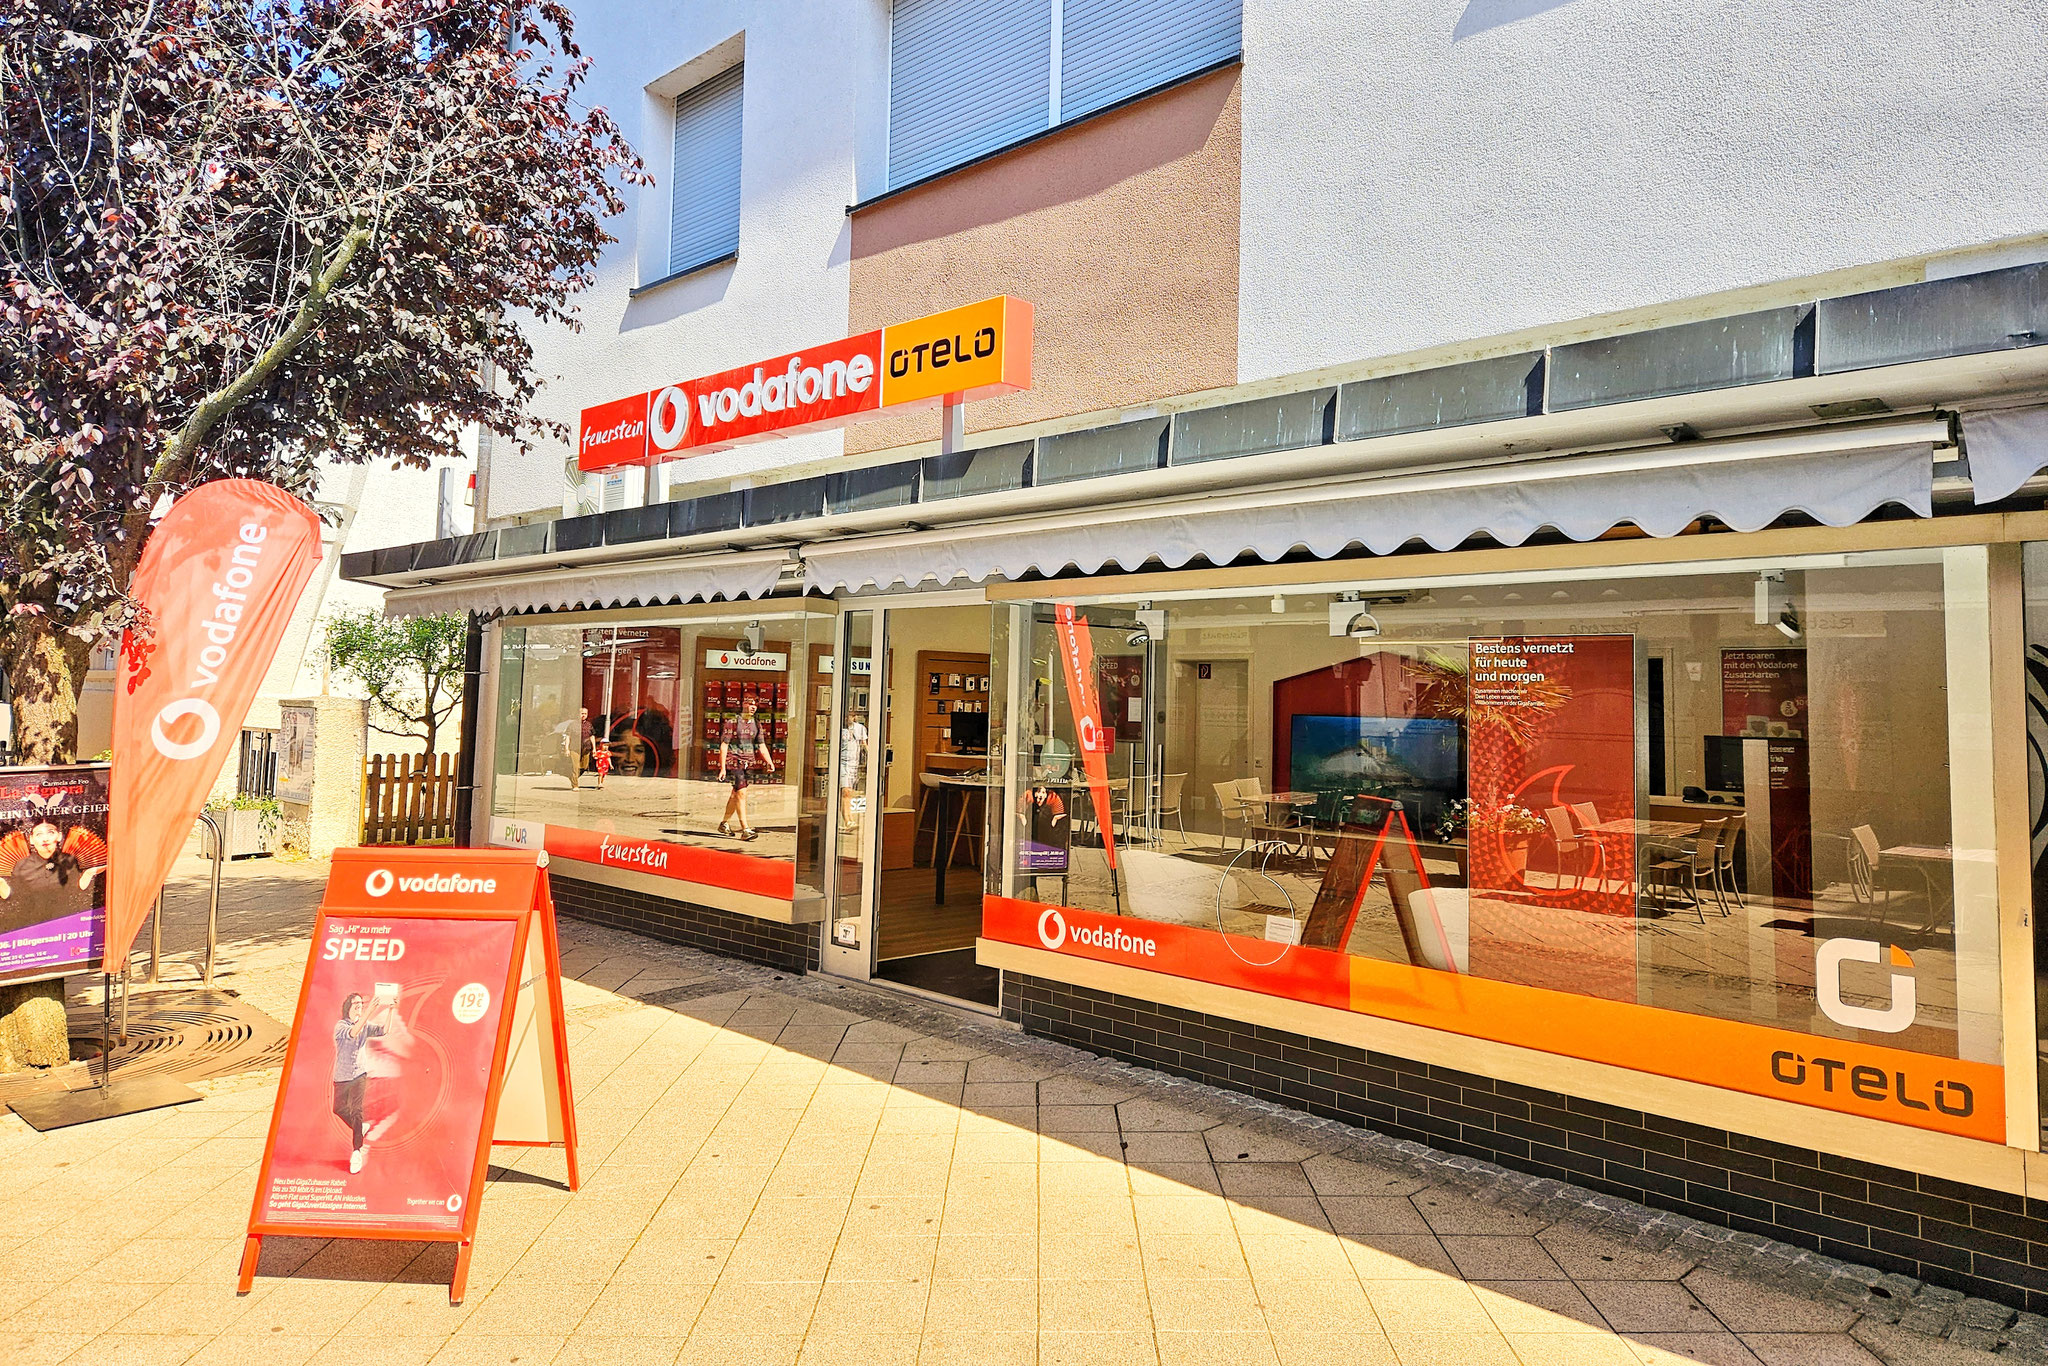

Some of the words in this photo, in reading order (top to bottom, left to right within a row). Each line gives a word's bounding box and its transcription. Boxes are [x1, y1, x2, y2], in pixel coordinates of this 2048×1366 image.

[698, 353, 875, 427] vodafone
[582, 419, 644, 454] feuerstein
[190, 522, 267, 689] vodafone
[1475, 642, 1521, 654] Bestens
[1523, 642, 1575, 654] vernetzt
[734, 656, 777, 667] vodafone
[1475, 656, 1492, 668] für
[1494, 657, 1528, 668] heute
[1724, 652, 1745, 660] Jetzt
[1746, 653, 1775, 661] sparen
[1724, 661, 1738, 669] mit
[1740, 661, 1756, 669] den
[1757, 661, 1799, 669] Vodafone
[1475, 671, 1497, 682] und
[1500, 672, 1545, 685] morgen
[1724, 671, 1780, 679] Zusatzkarten
[25, 806, 70, 818] UNTER
[599, 834, 668, 869] feuerstein
[398, 873, 497, 894] vodafone
[328, 925, 344, 935] Sag
[370, 926, 392, 935] mehr
[17, 934, 62, 947] Bürgersaal
[67, 932, 78, 940] 20
[79, 930, 94, 939] Uhr
[1069, 924, 1156, 957] vodafone
[322, 938, 406, 962] SPEED
[460, 993, 476, 1008] 19
[268, 1200, 277, 1208] So
[277, 1201, 292, 1209] geht
